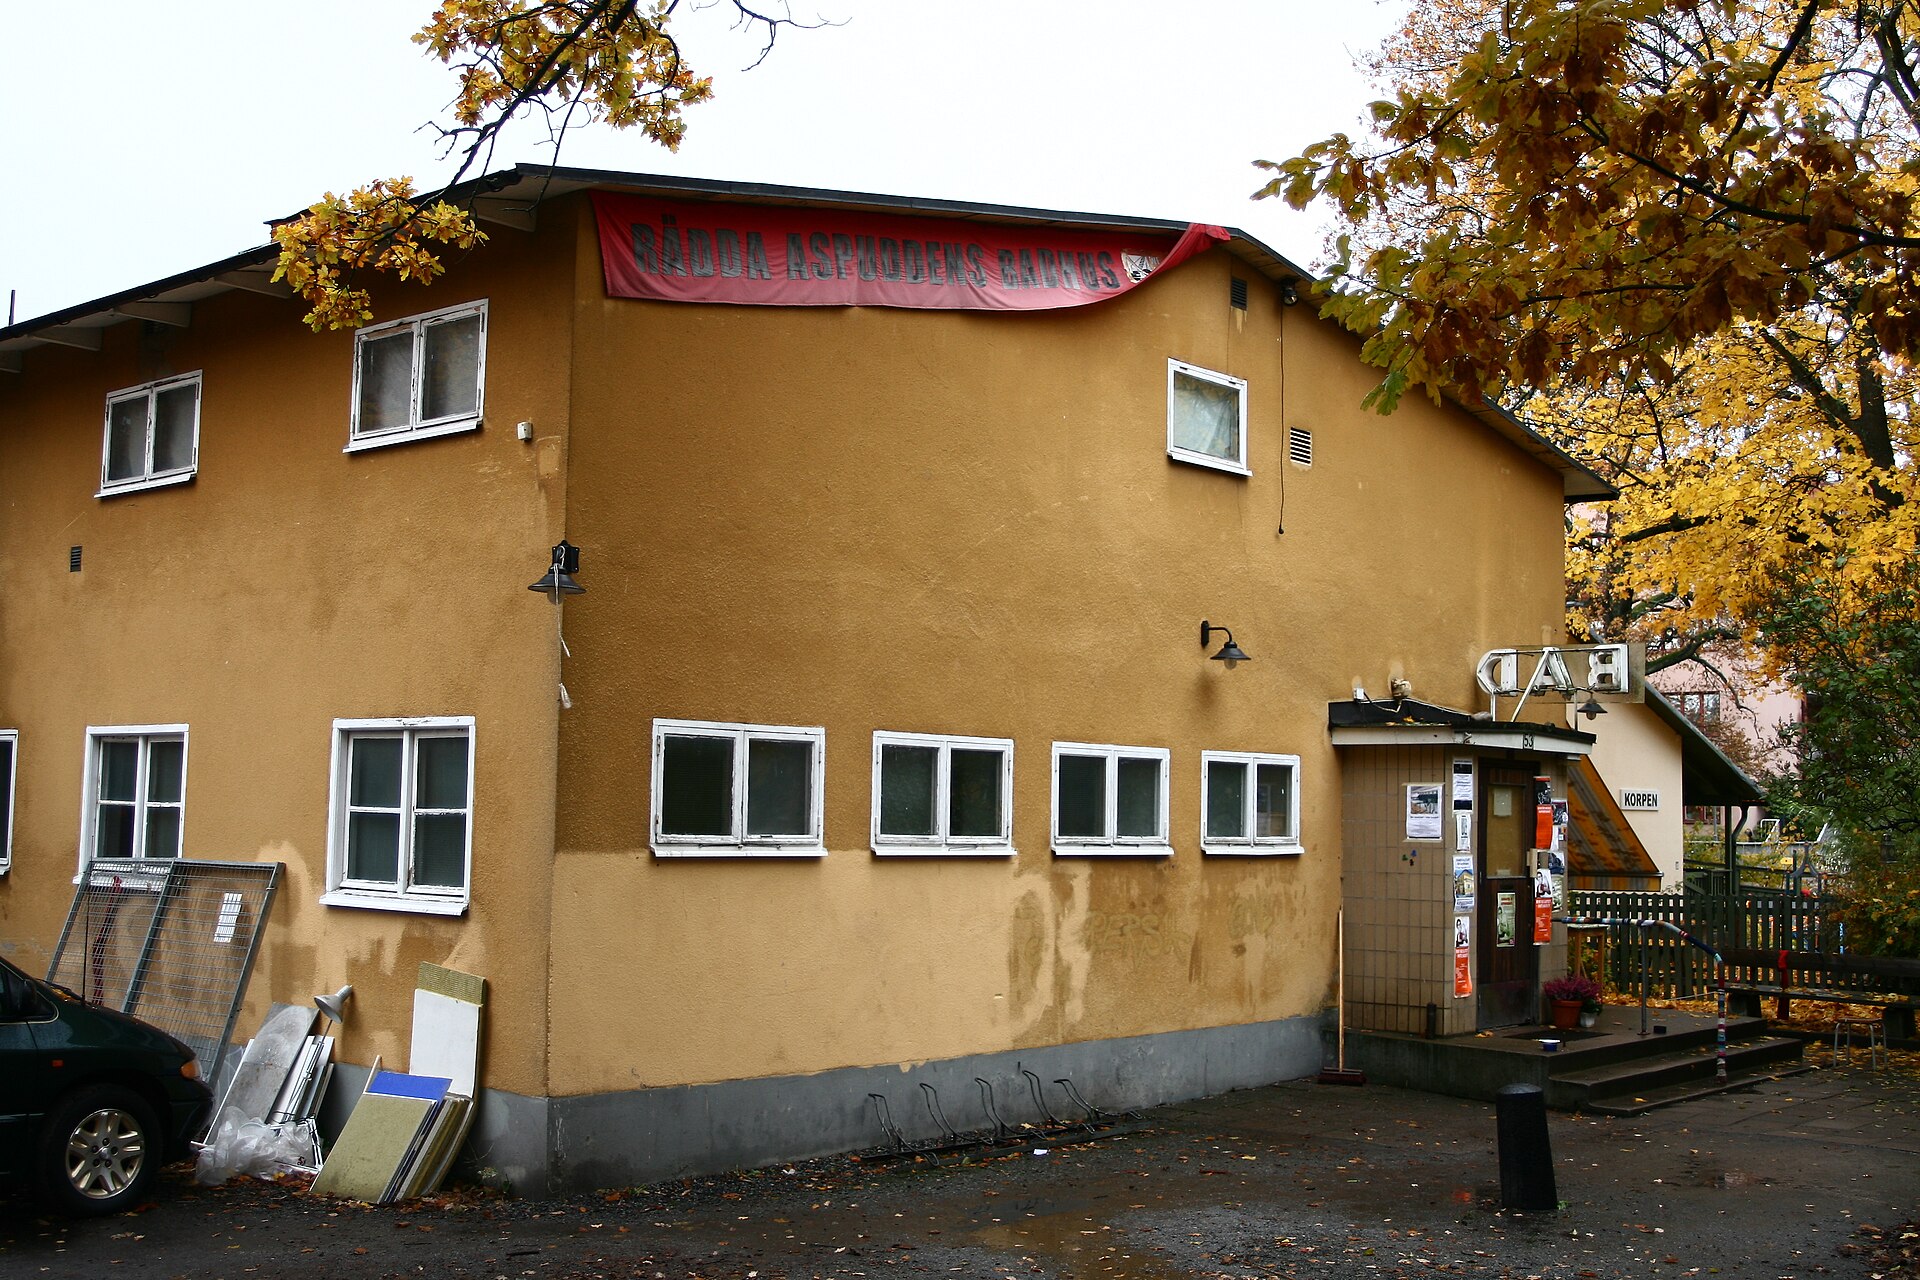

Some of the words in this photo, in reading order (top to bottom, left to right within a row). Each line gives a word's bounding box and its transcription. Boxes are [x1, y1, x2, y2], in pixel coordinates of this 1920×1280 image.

[631, 213, 772, 280] RÄDDA
[786, 231, 988, 288] ASPUDDENS
[999, 248, 1121, 290] BADHUS
[1523, 734, 1534, 748] 53
[1624, 792, 1658, 807] KORPEN
